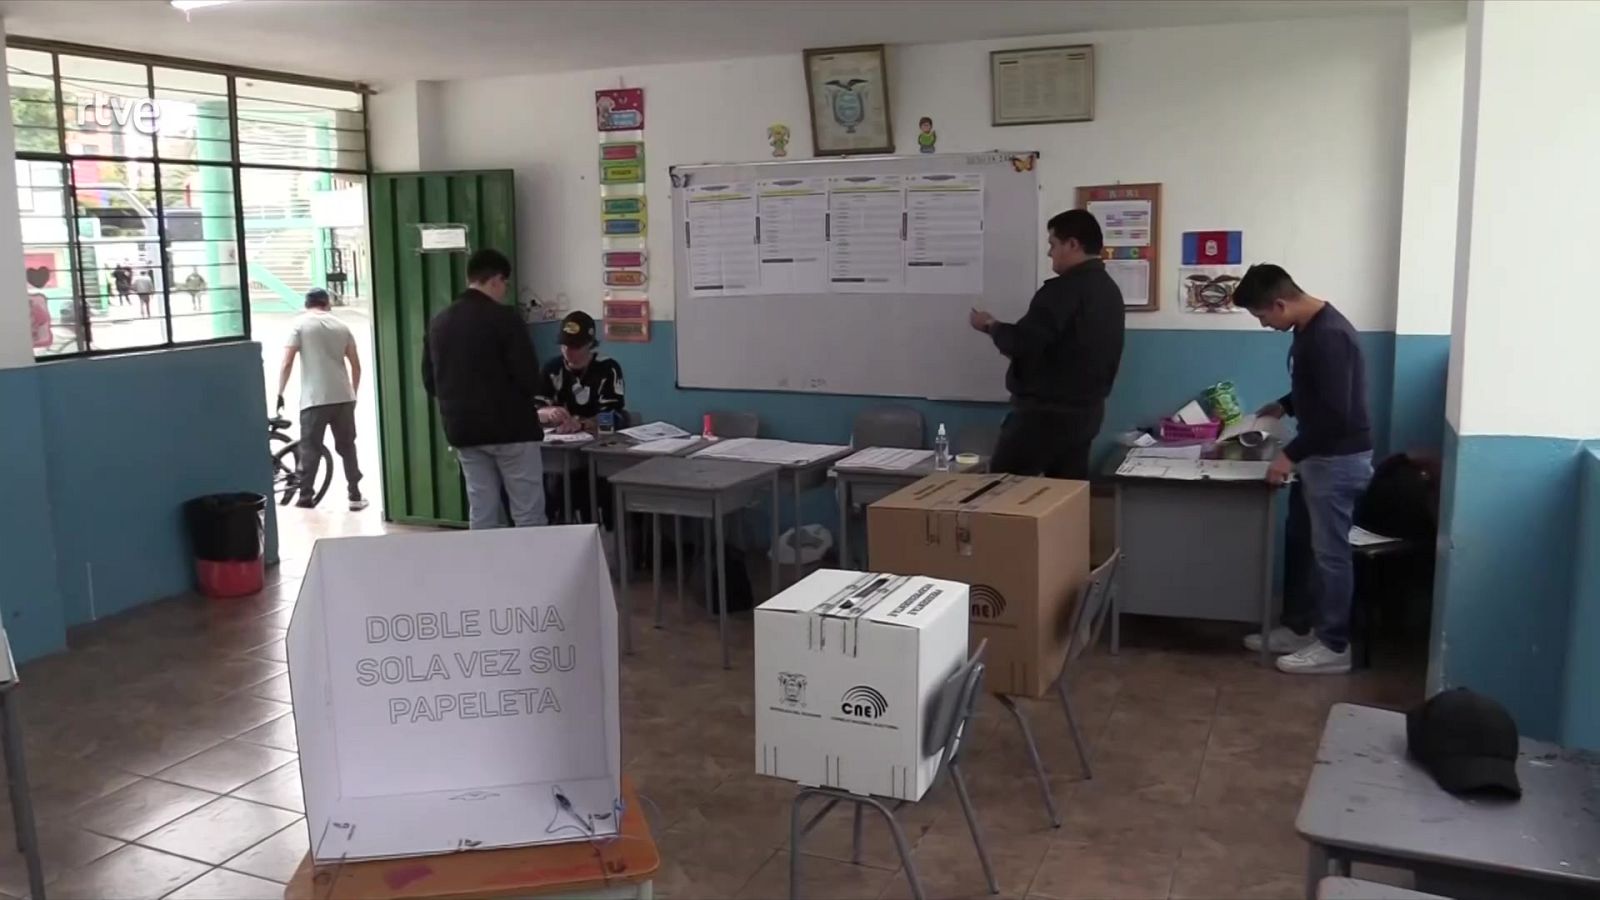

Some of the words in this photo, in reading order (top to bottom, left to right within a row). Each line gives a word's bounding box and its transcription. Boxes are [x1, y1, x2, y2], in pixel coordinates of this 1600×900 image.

[366, 609, 481, 643] DOBLE
[489, 605, 565, 634] UNA
[356, 654, 450, 686] SOLA
[454, 649, 521, 678] VEZ
[530, 645, 576, 673] SU
[389, 687, 562, 724] PAPELETA
